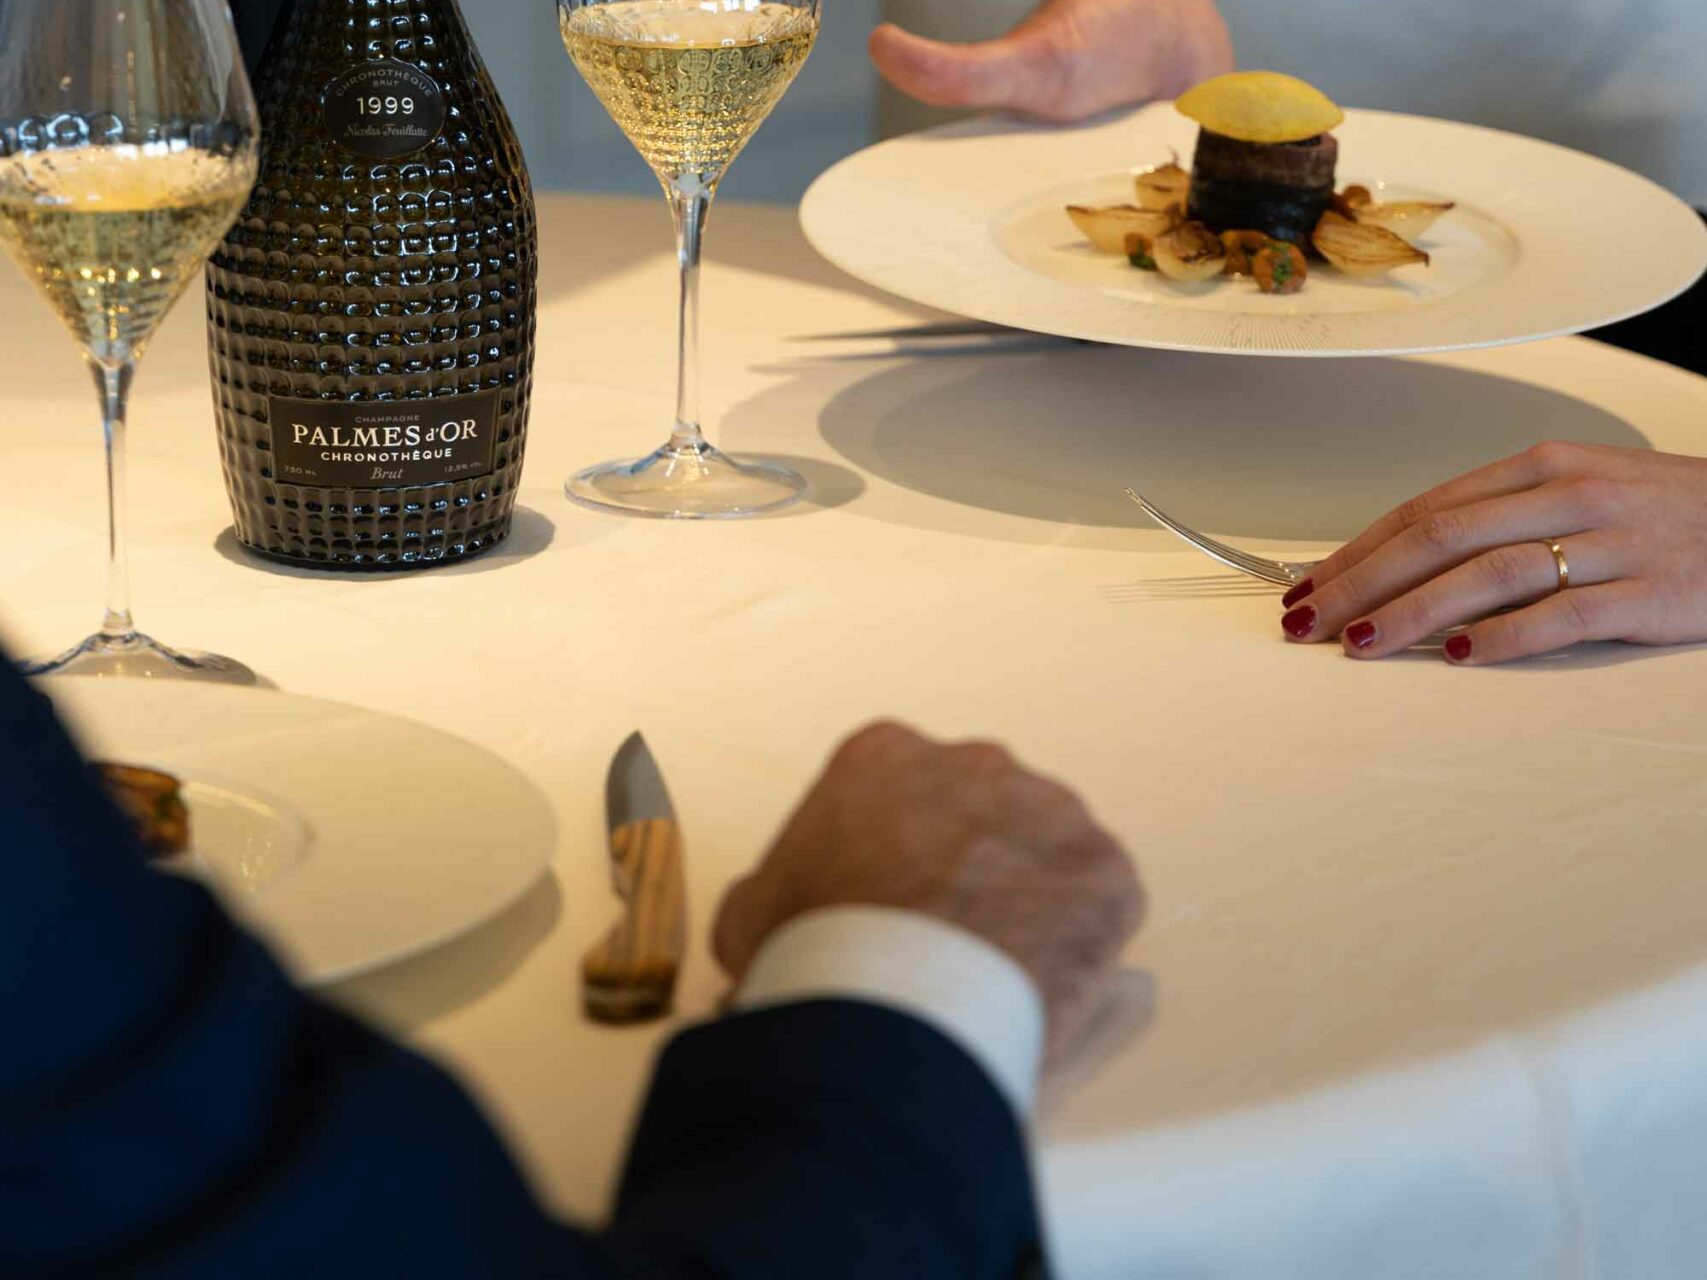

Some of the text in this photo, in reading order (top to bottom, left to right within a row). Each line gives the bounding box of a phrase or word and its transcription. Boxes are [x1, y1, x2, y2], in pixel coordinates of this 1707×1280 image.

[372, 79, 400, 87] BRUT
[356, 96, 415, 115] 1999
[343, 122, 429, 136] Nicolas Feuillatte
[354, 414, 421, 423] CHAMPAGNE
[291, 419, 478, 447] PALMES d'OR
[320, 448, 453, 462] CHRONOTHÈQUE
[284, 465, 303, 475] 750
[370, 466, 404, 480] Brut
